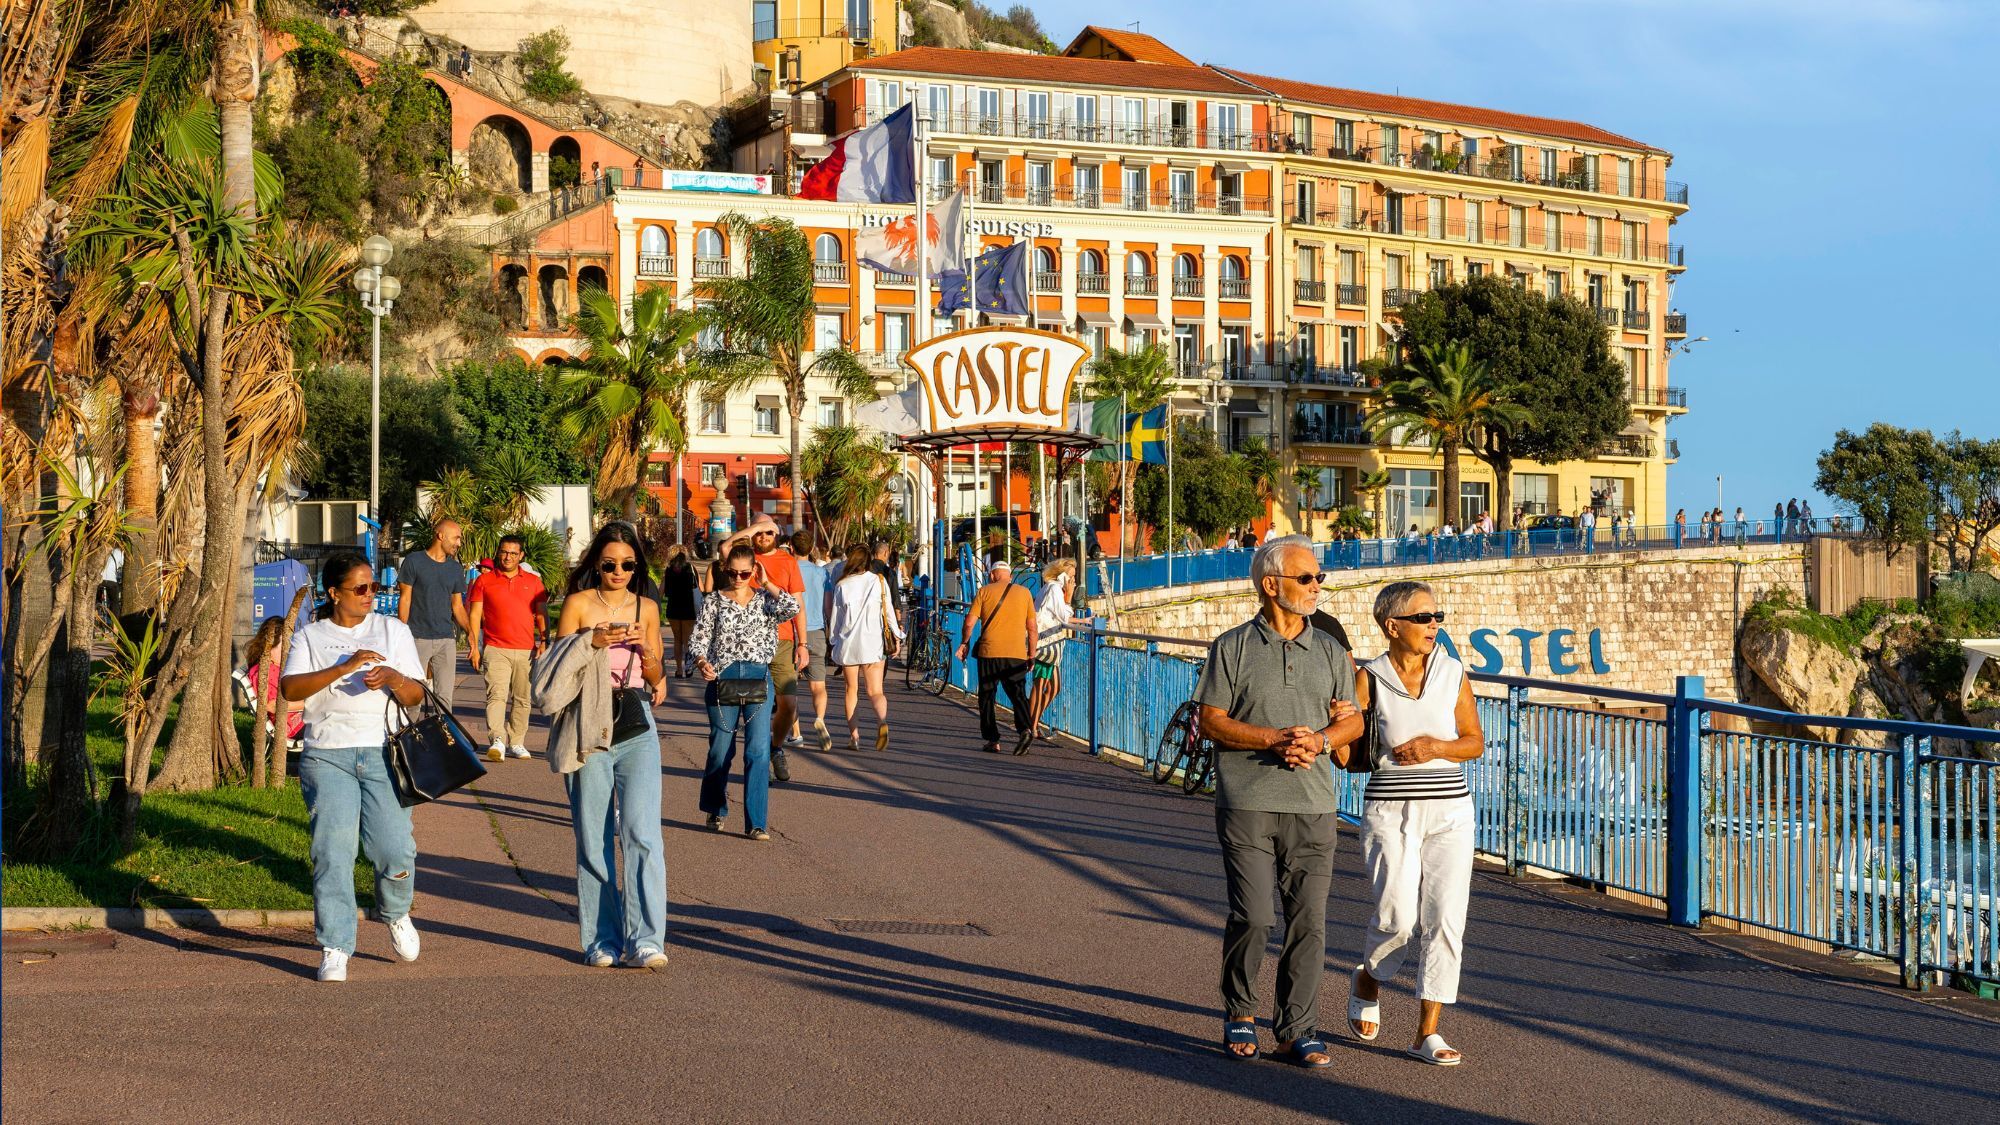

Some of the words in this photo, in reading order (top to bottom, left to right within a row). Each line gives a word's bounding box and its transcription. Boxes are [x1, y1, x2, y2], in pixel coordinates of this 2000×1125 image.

[965, 220, 1053, 237] SUISSE
[933, 341, 1060, 419] CASTEL
[1436, 627, 1611, 676] ASTEL
